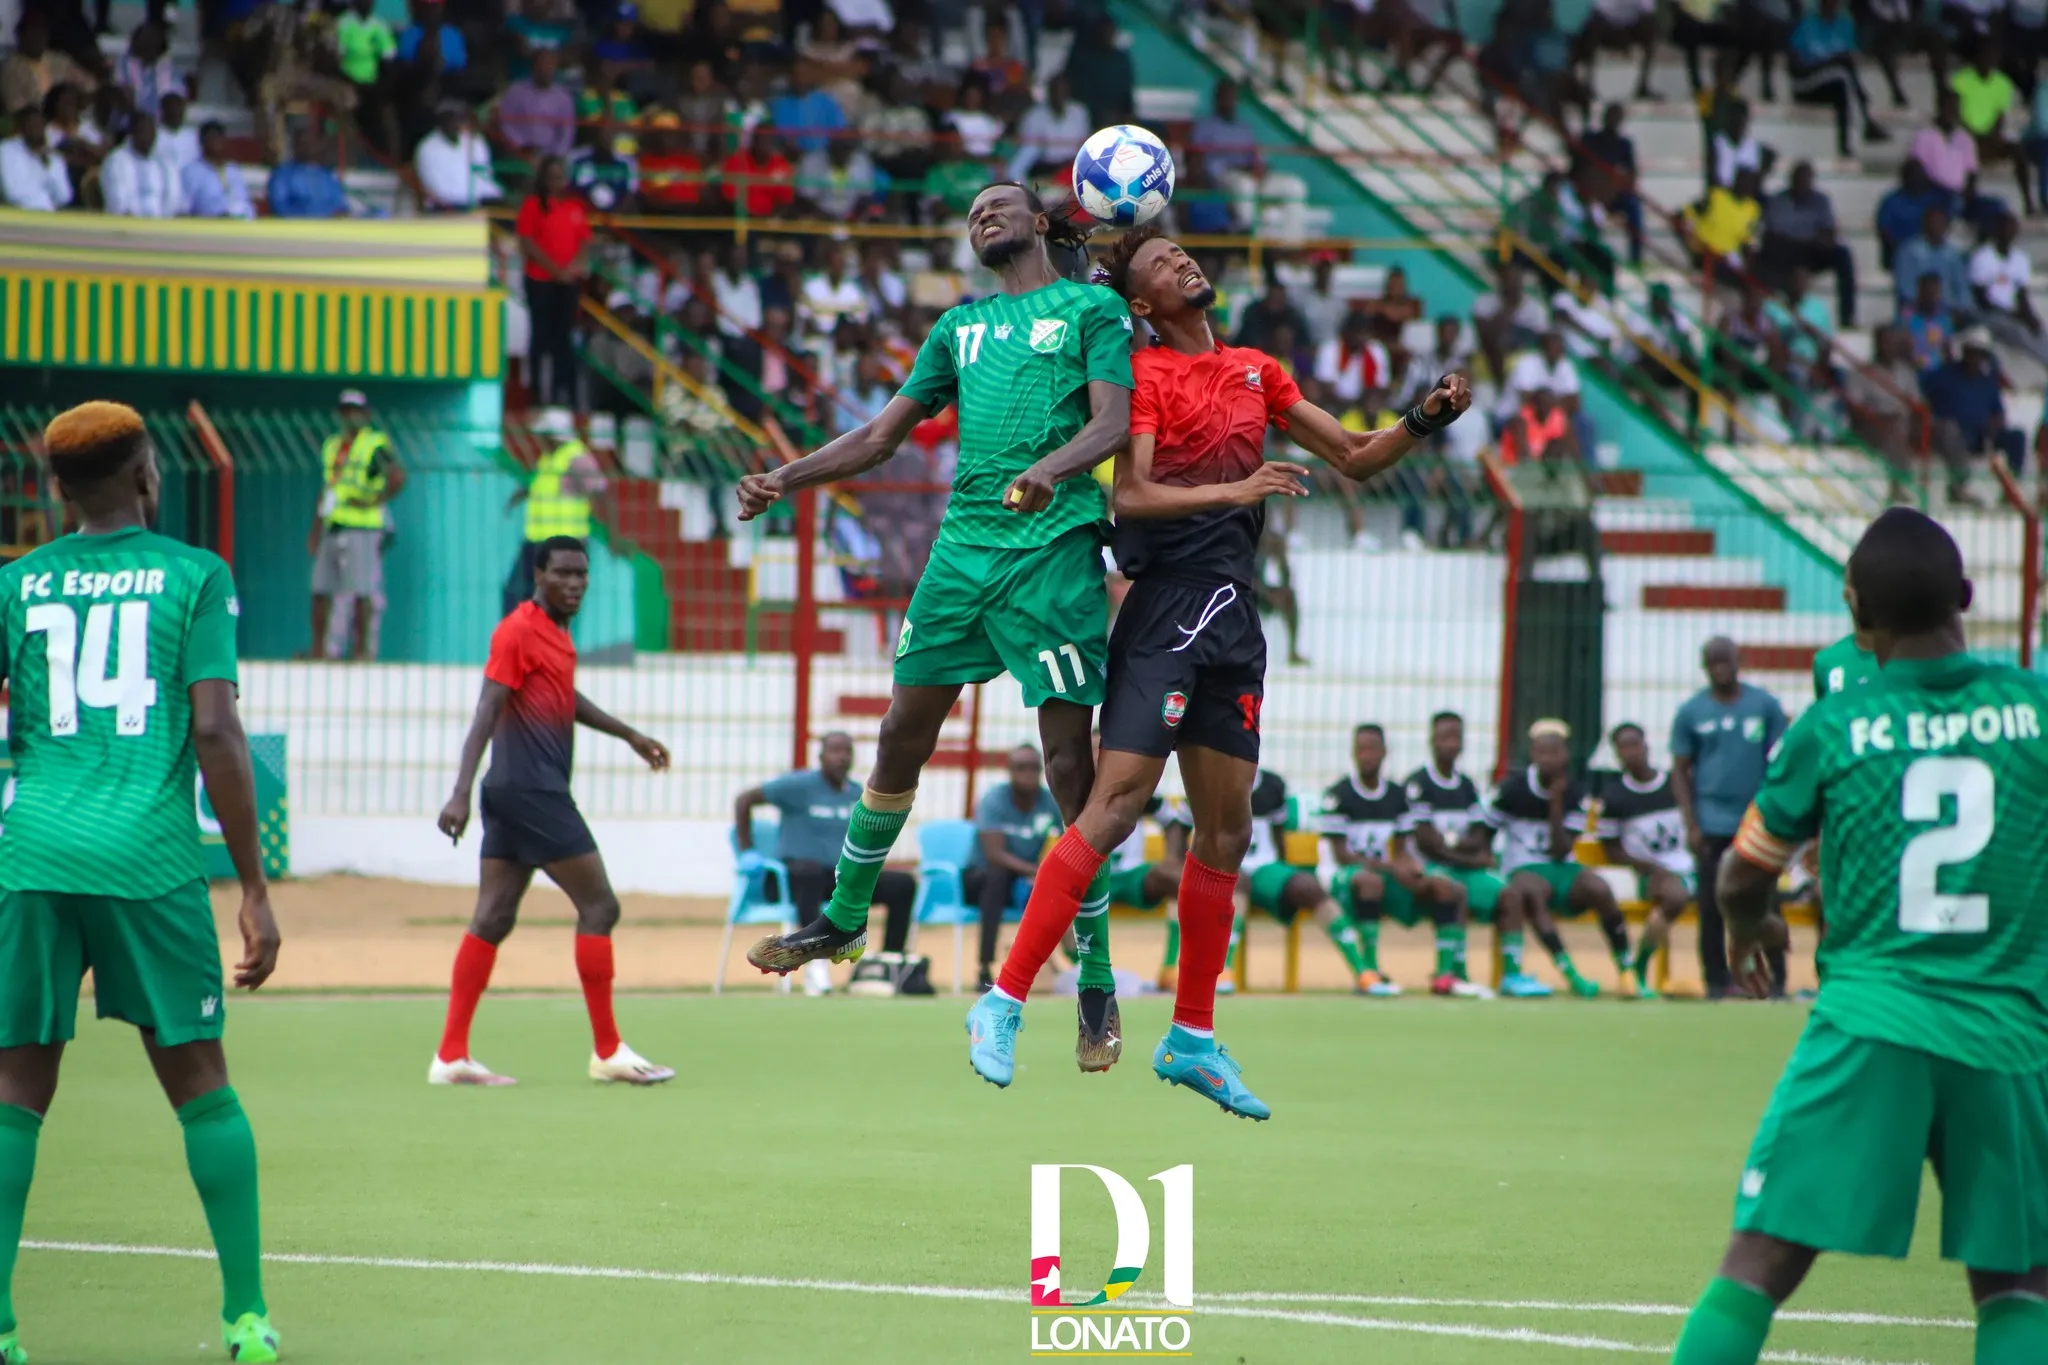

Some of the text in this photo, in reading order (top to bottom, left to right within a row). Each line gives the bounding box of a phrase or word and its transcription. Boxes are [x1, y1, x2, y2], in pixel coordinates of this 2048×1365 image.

[20, 568, 165, 601] FC ESPOIR
[26, 600, 157, 737] 14
[1038, 642, 1086, 694] 11
[1850, 703, 2041, 756] FC ESPOIR
[1898, 755, 1996, 934] 2
